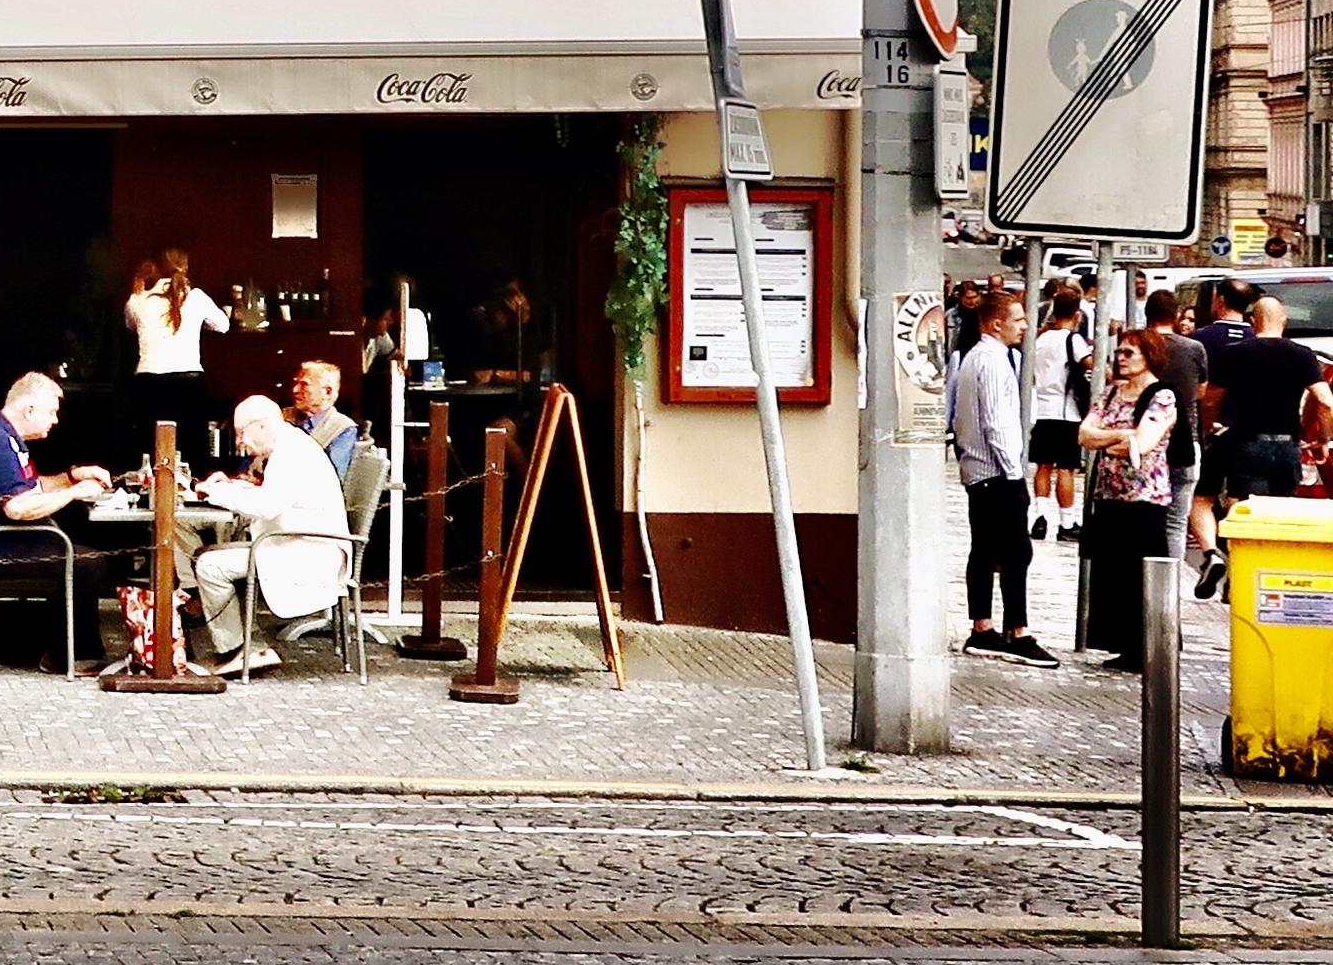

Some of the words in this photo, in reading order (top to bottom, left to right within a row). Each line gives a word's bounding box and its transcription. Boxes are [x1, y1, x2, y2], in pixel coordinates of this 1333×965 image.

[874, 40, 909, 61] 114
[817, 69, 862, 99] Coca
[887, 64, 910, 84] 16
[377, 73, 473, 104] Coca-Cola
